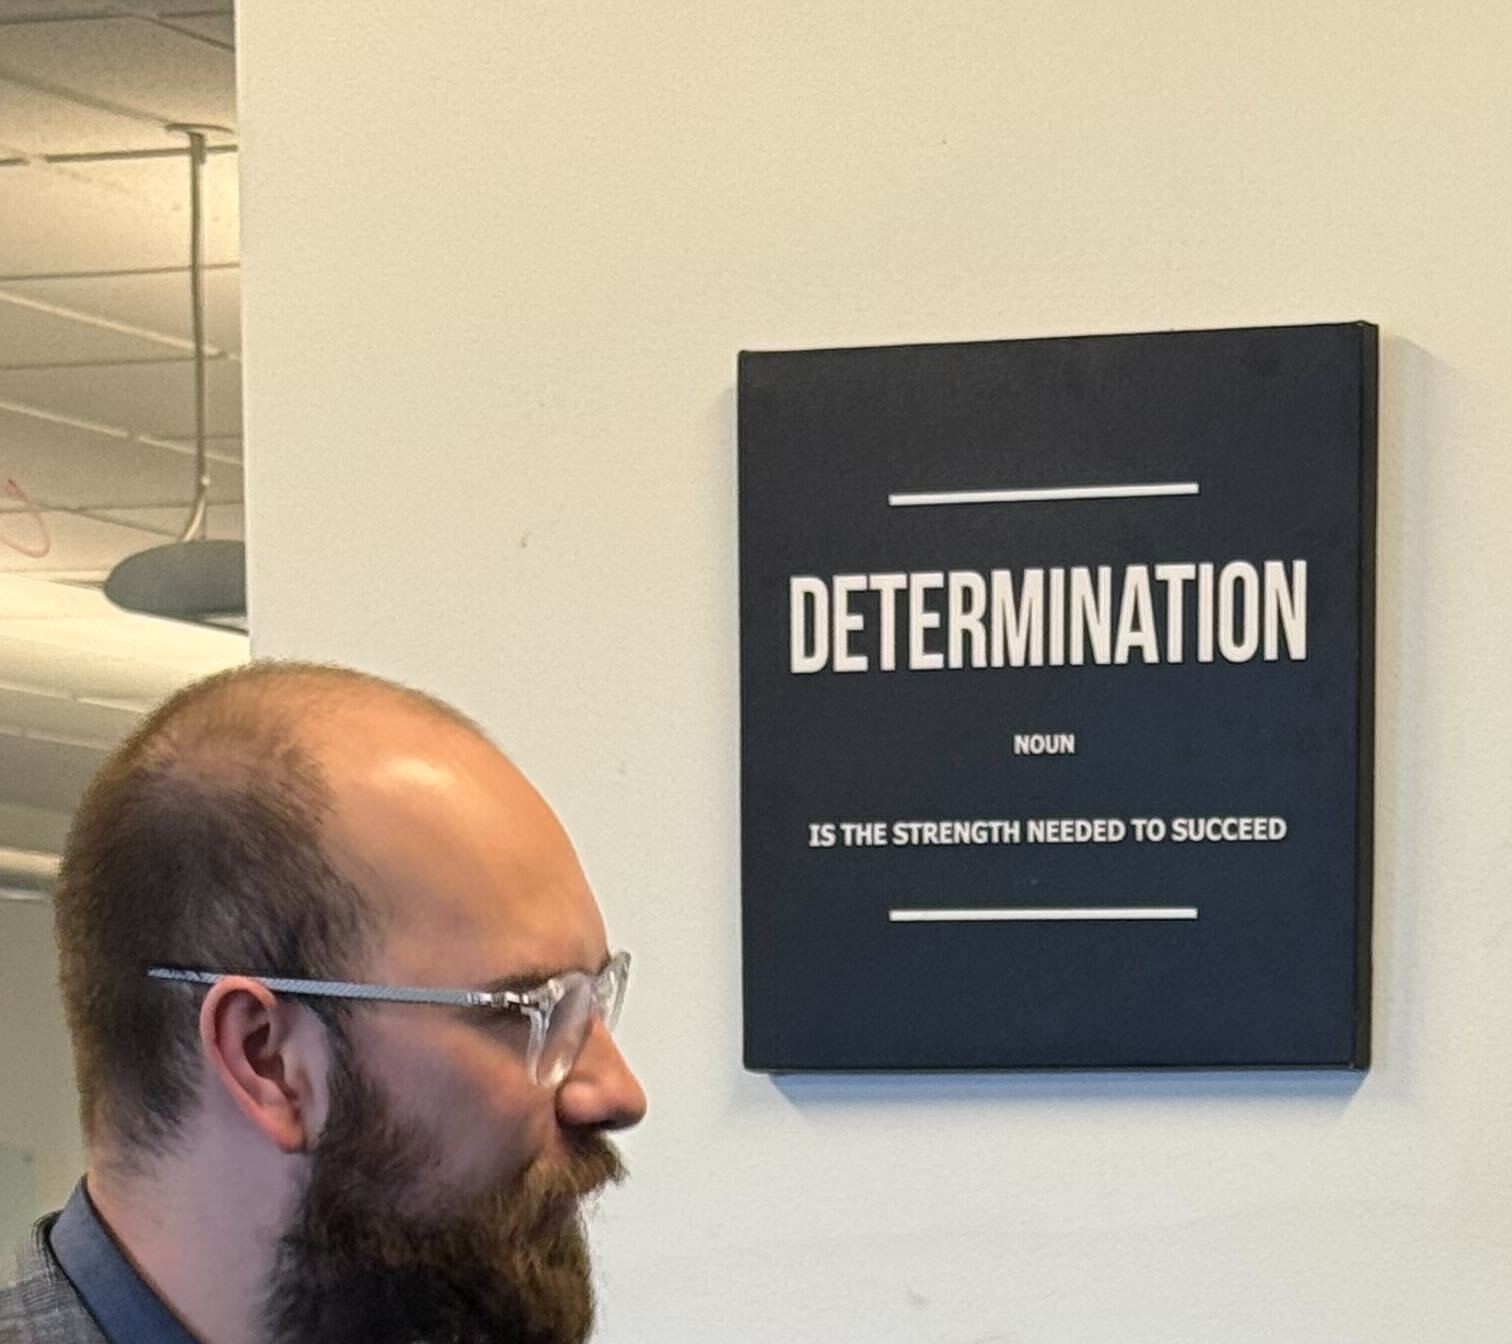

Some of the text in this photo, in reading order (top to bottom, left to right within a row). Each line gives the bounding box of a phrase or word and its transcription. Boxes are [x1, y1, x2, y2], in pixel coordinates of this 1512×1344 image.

[789, 559, 1308, 674] DETERMINATION
[1013, 732, 1076, 756] NOUN
[808, 815, 1288, 848] IS THE STRENGTH NEEDED TO SUCCEED
